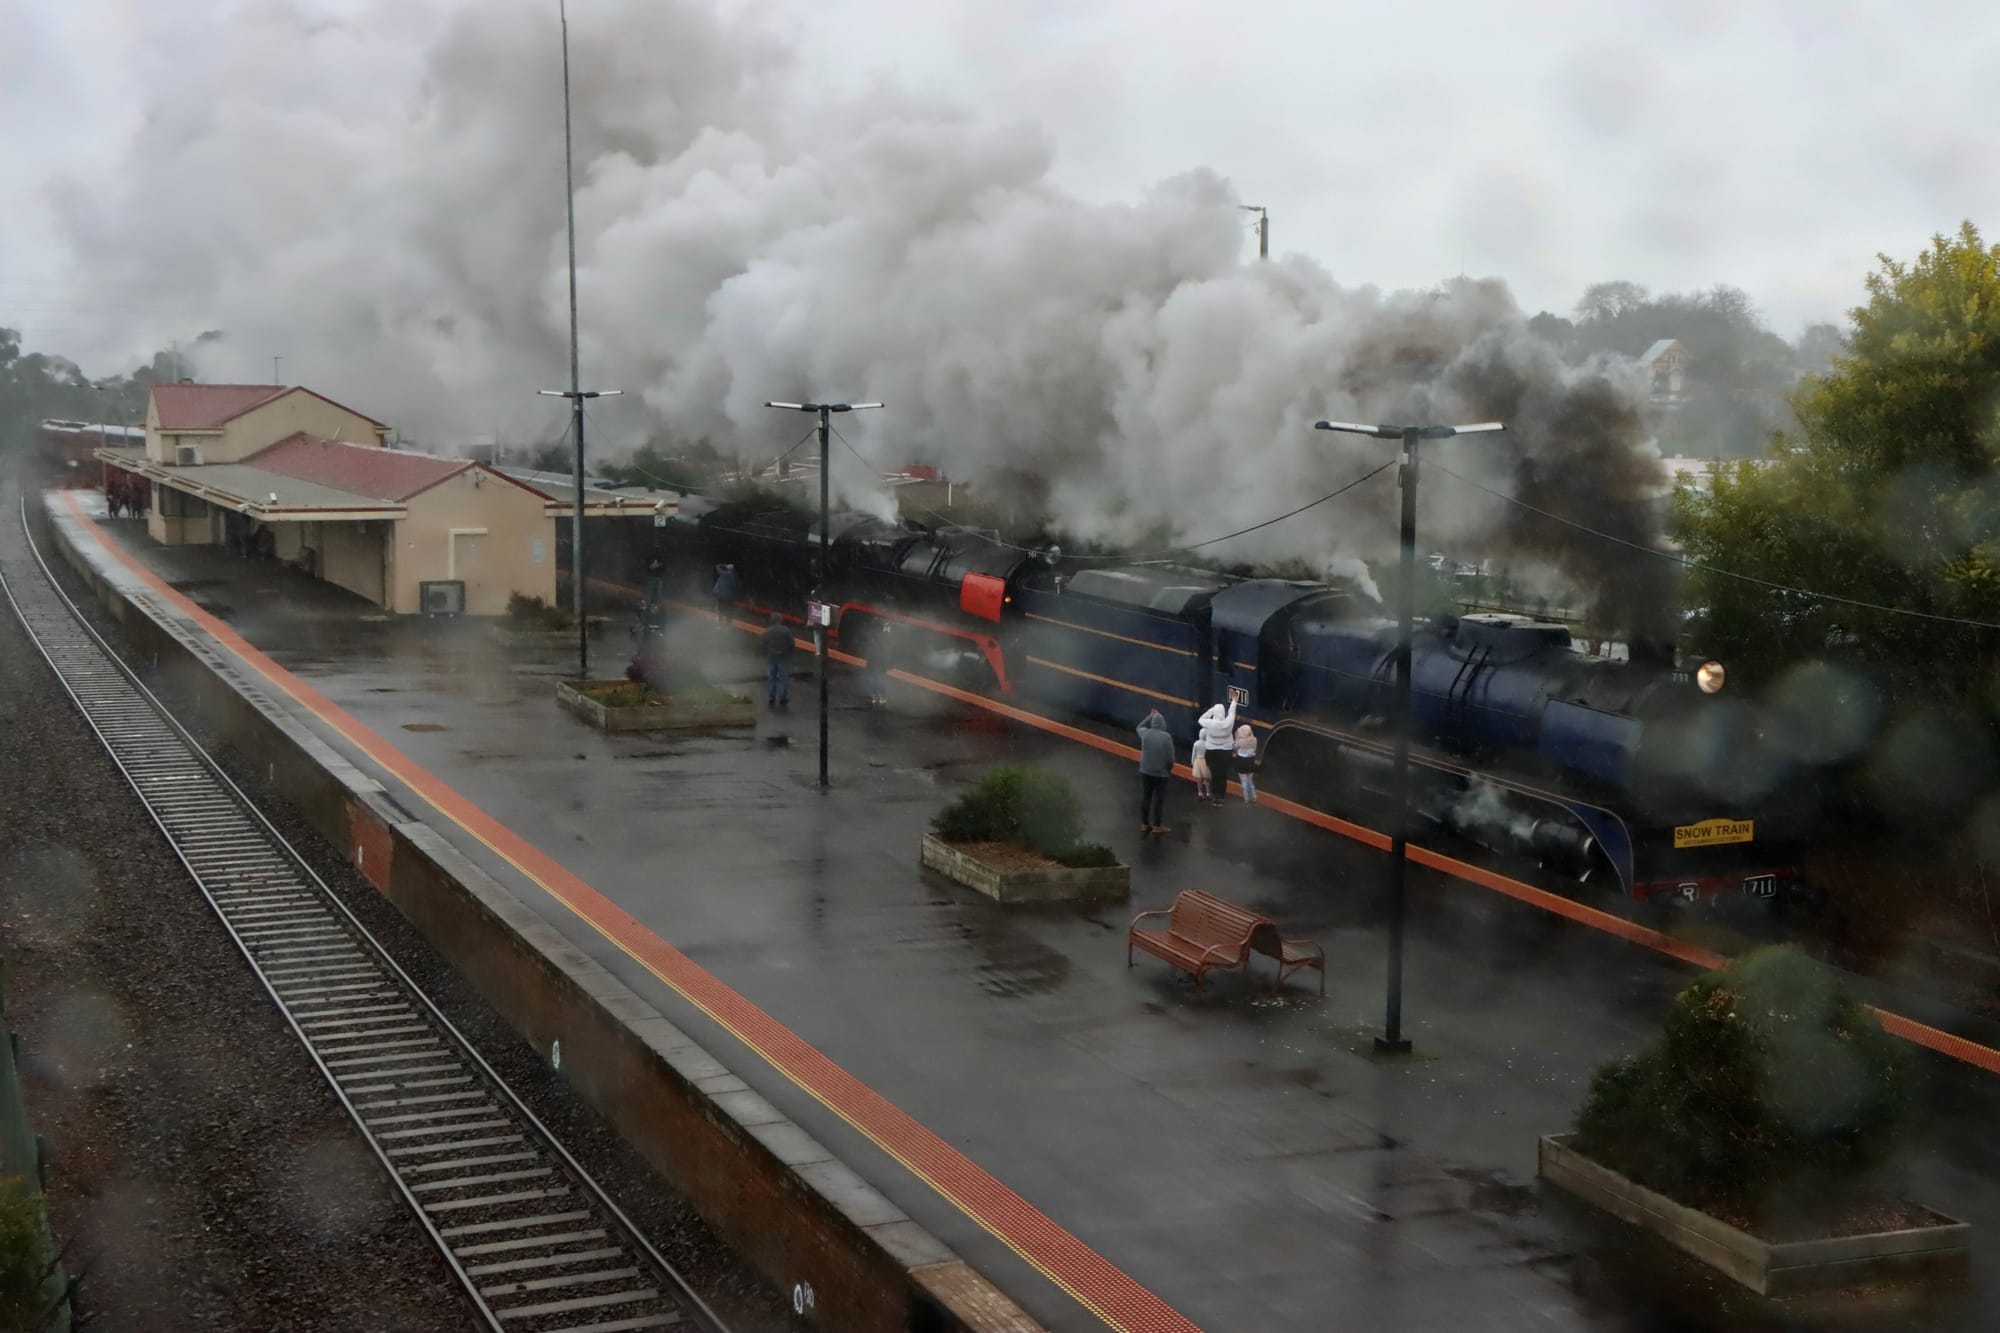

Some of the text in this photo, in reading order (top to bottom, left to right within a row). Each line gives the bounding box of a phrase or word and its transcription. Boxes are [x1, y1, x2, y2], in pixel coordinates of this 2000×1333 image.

[1676, 823, 1750, 840] SNOW TRAIN
[1683, 887, 1694, 902] R
[1752, 879, 1772, 895] 711
